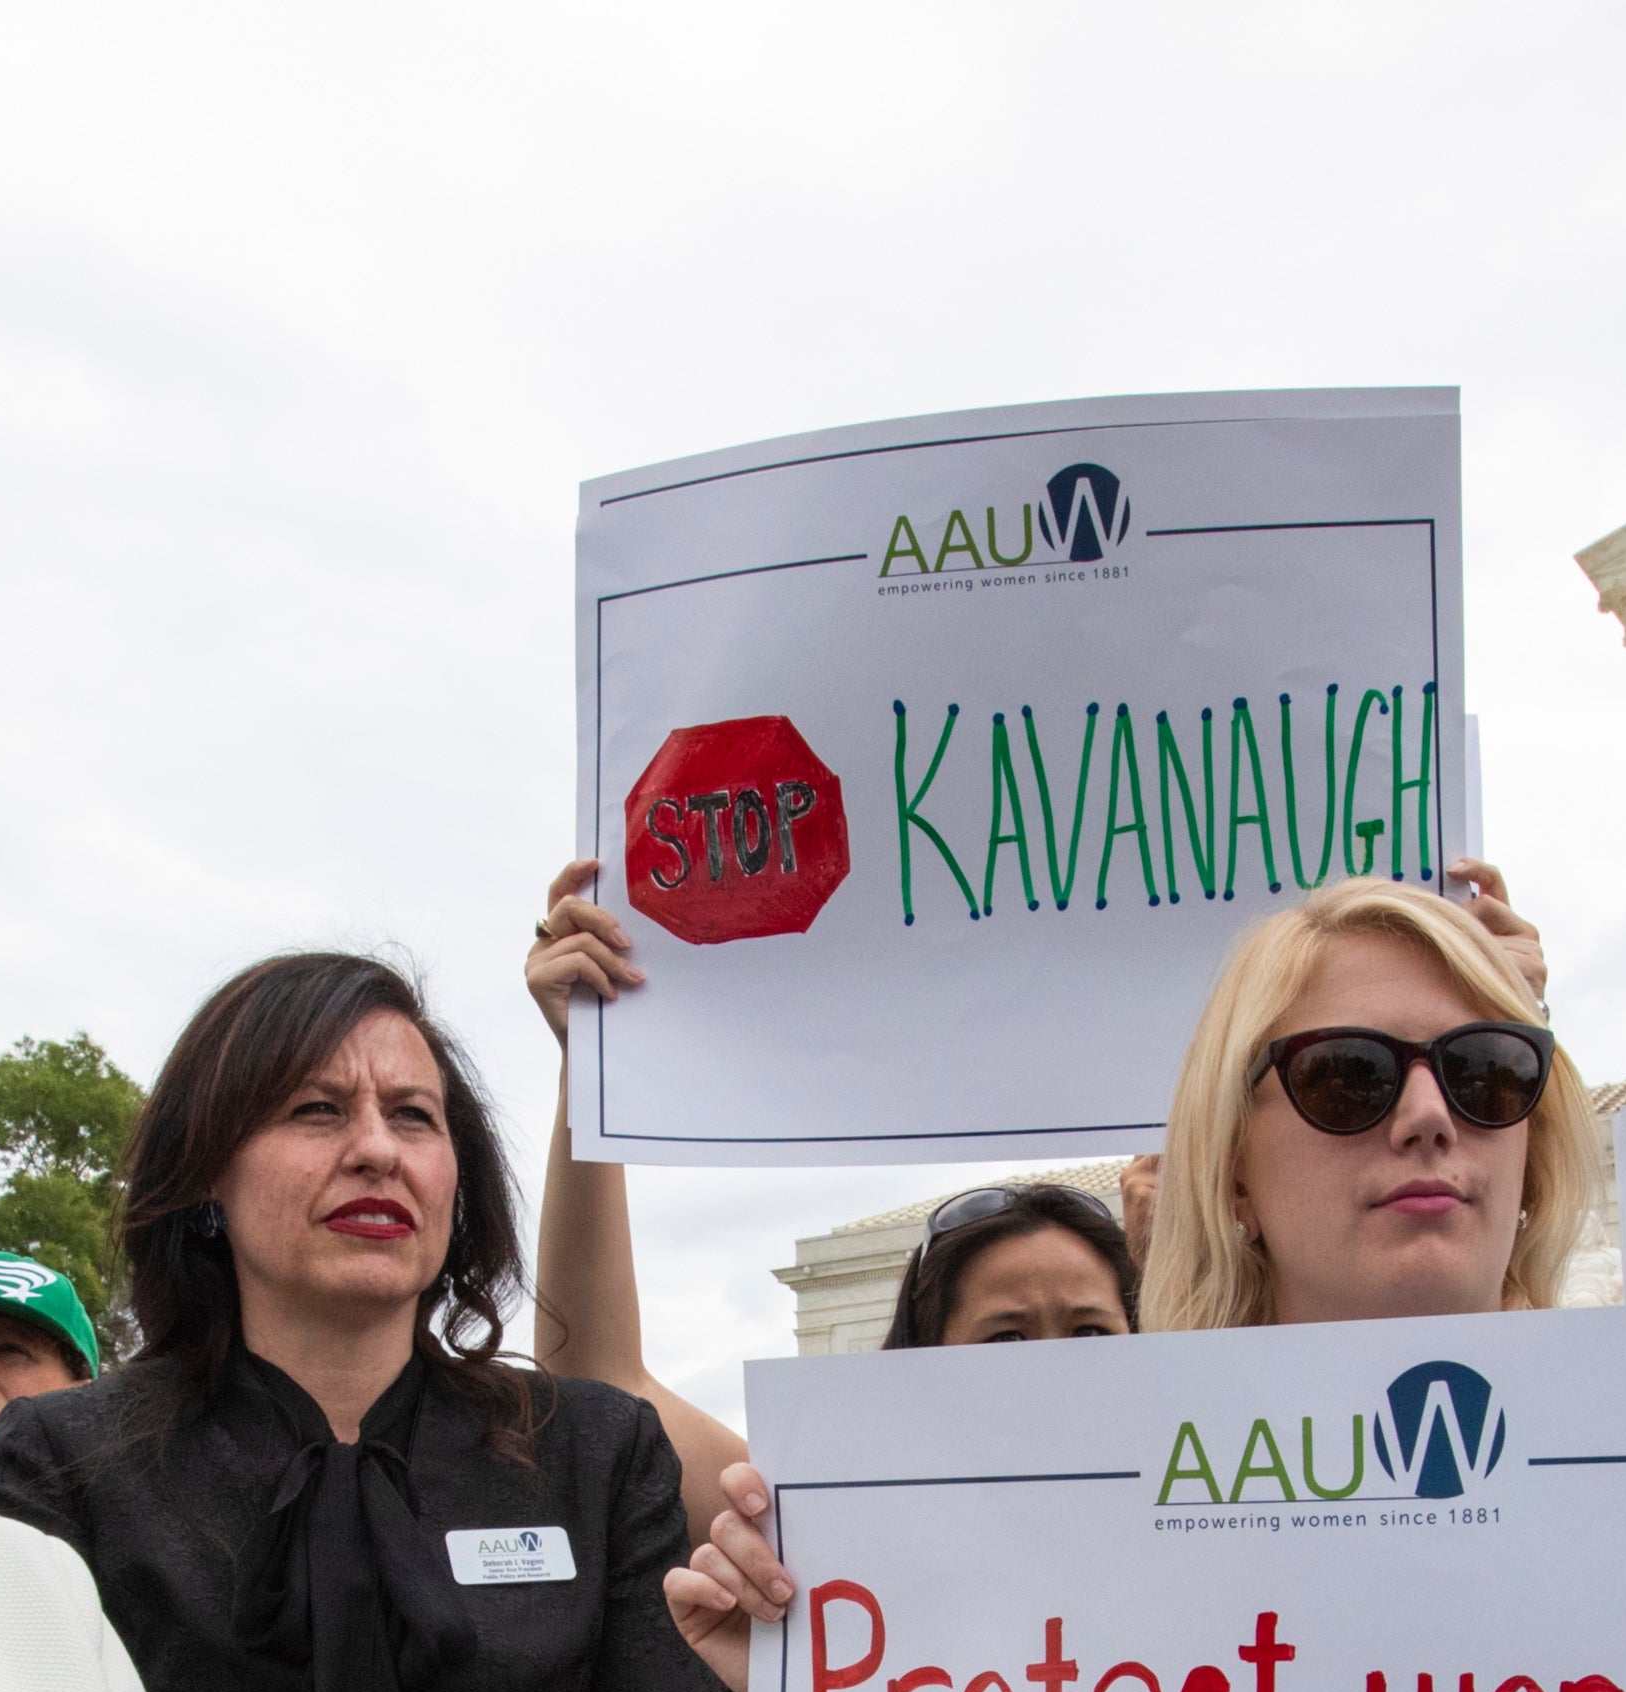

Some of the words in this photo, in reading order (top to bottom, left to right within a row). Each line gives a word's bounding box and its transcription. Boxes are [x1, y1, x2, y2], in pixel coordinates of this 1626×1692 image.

[879, 463, 1131, 577] AAUW
[878, 578, 973, 597] empowering
[981, 573, 1037, 588] women
[1045, 568, 1085, 583] since
[1093, 566, 1129, 580] 1881
[646, 780, 817, 889] STOP
[893, 681, 1435, 926] KAVANAUGH
[1157, 1360, 1506, 1504] AAUW
[478, 1531, 542, 1553] AAUW
[1154, 1513, 1280, 1533] empowering
[1291, 1512, 1367, 1528] women
[1380, 1510, 1437, 1525] since
[1448, 1508, 1501, 1524] 1881
